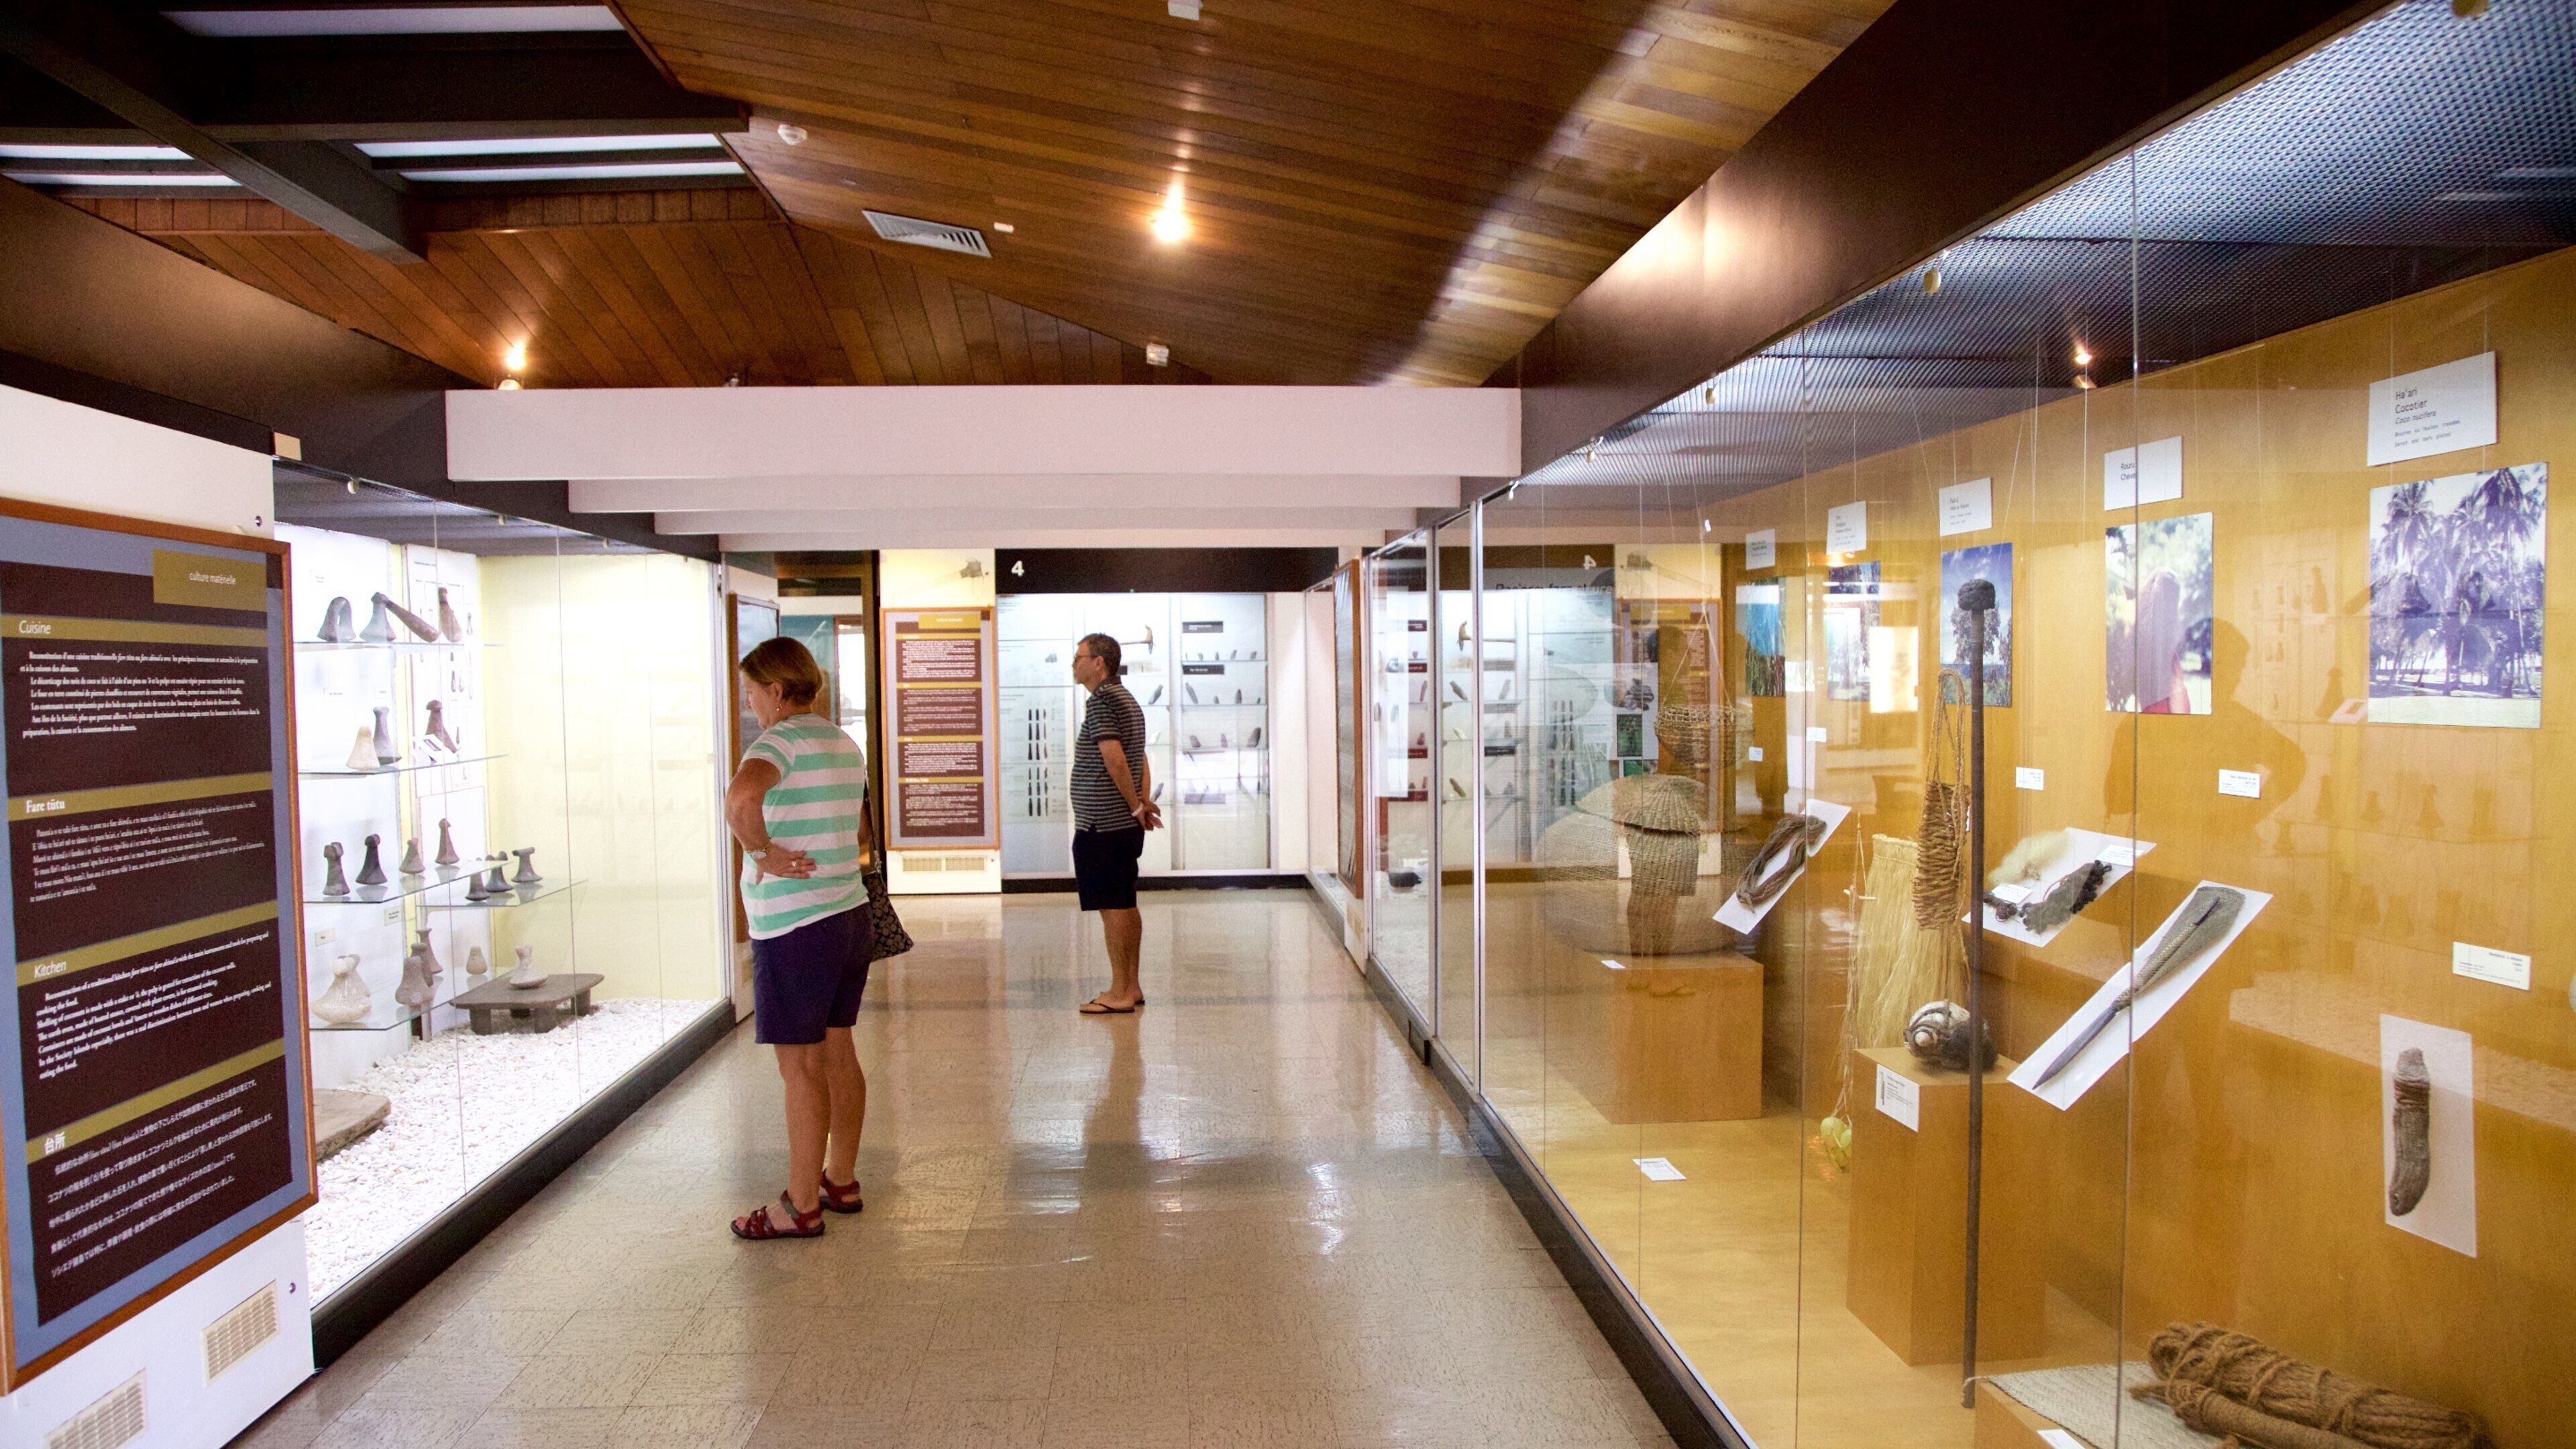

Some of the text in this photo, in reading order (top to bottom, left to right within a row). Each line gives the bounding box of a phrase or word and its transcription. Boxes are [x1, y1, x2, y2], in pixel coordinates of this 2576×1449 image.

[2396, 400, 2427, 414] Cocotier
[1011, 560, 1025, 577] 4
[189, 571, 209, 582] culture
[19, 620, 52, 635] Cuisine
[26, 800, 45, 814] Fare
[34, 961, 66, 978] Kitchen
[44, 1131, 65, 1155] 台所
